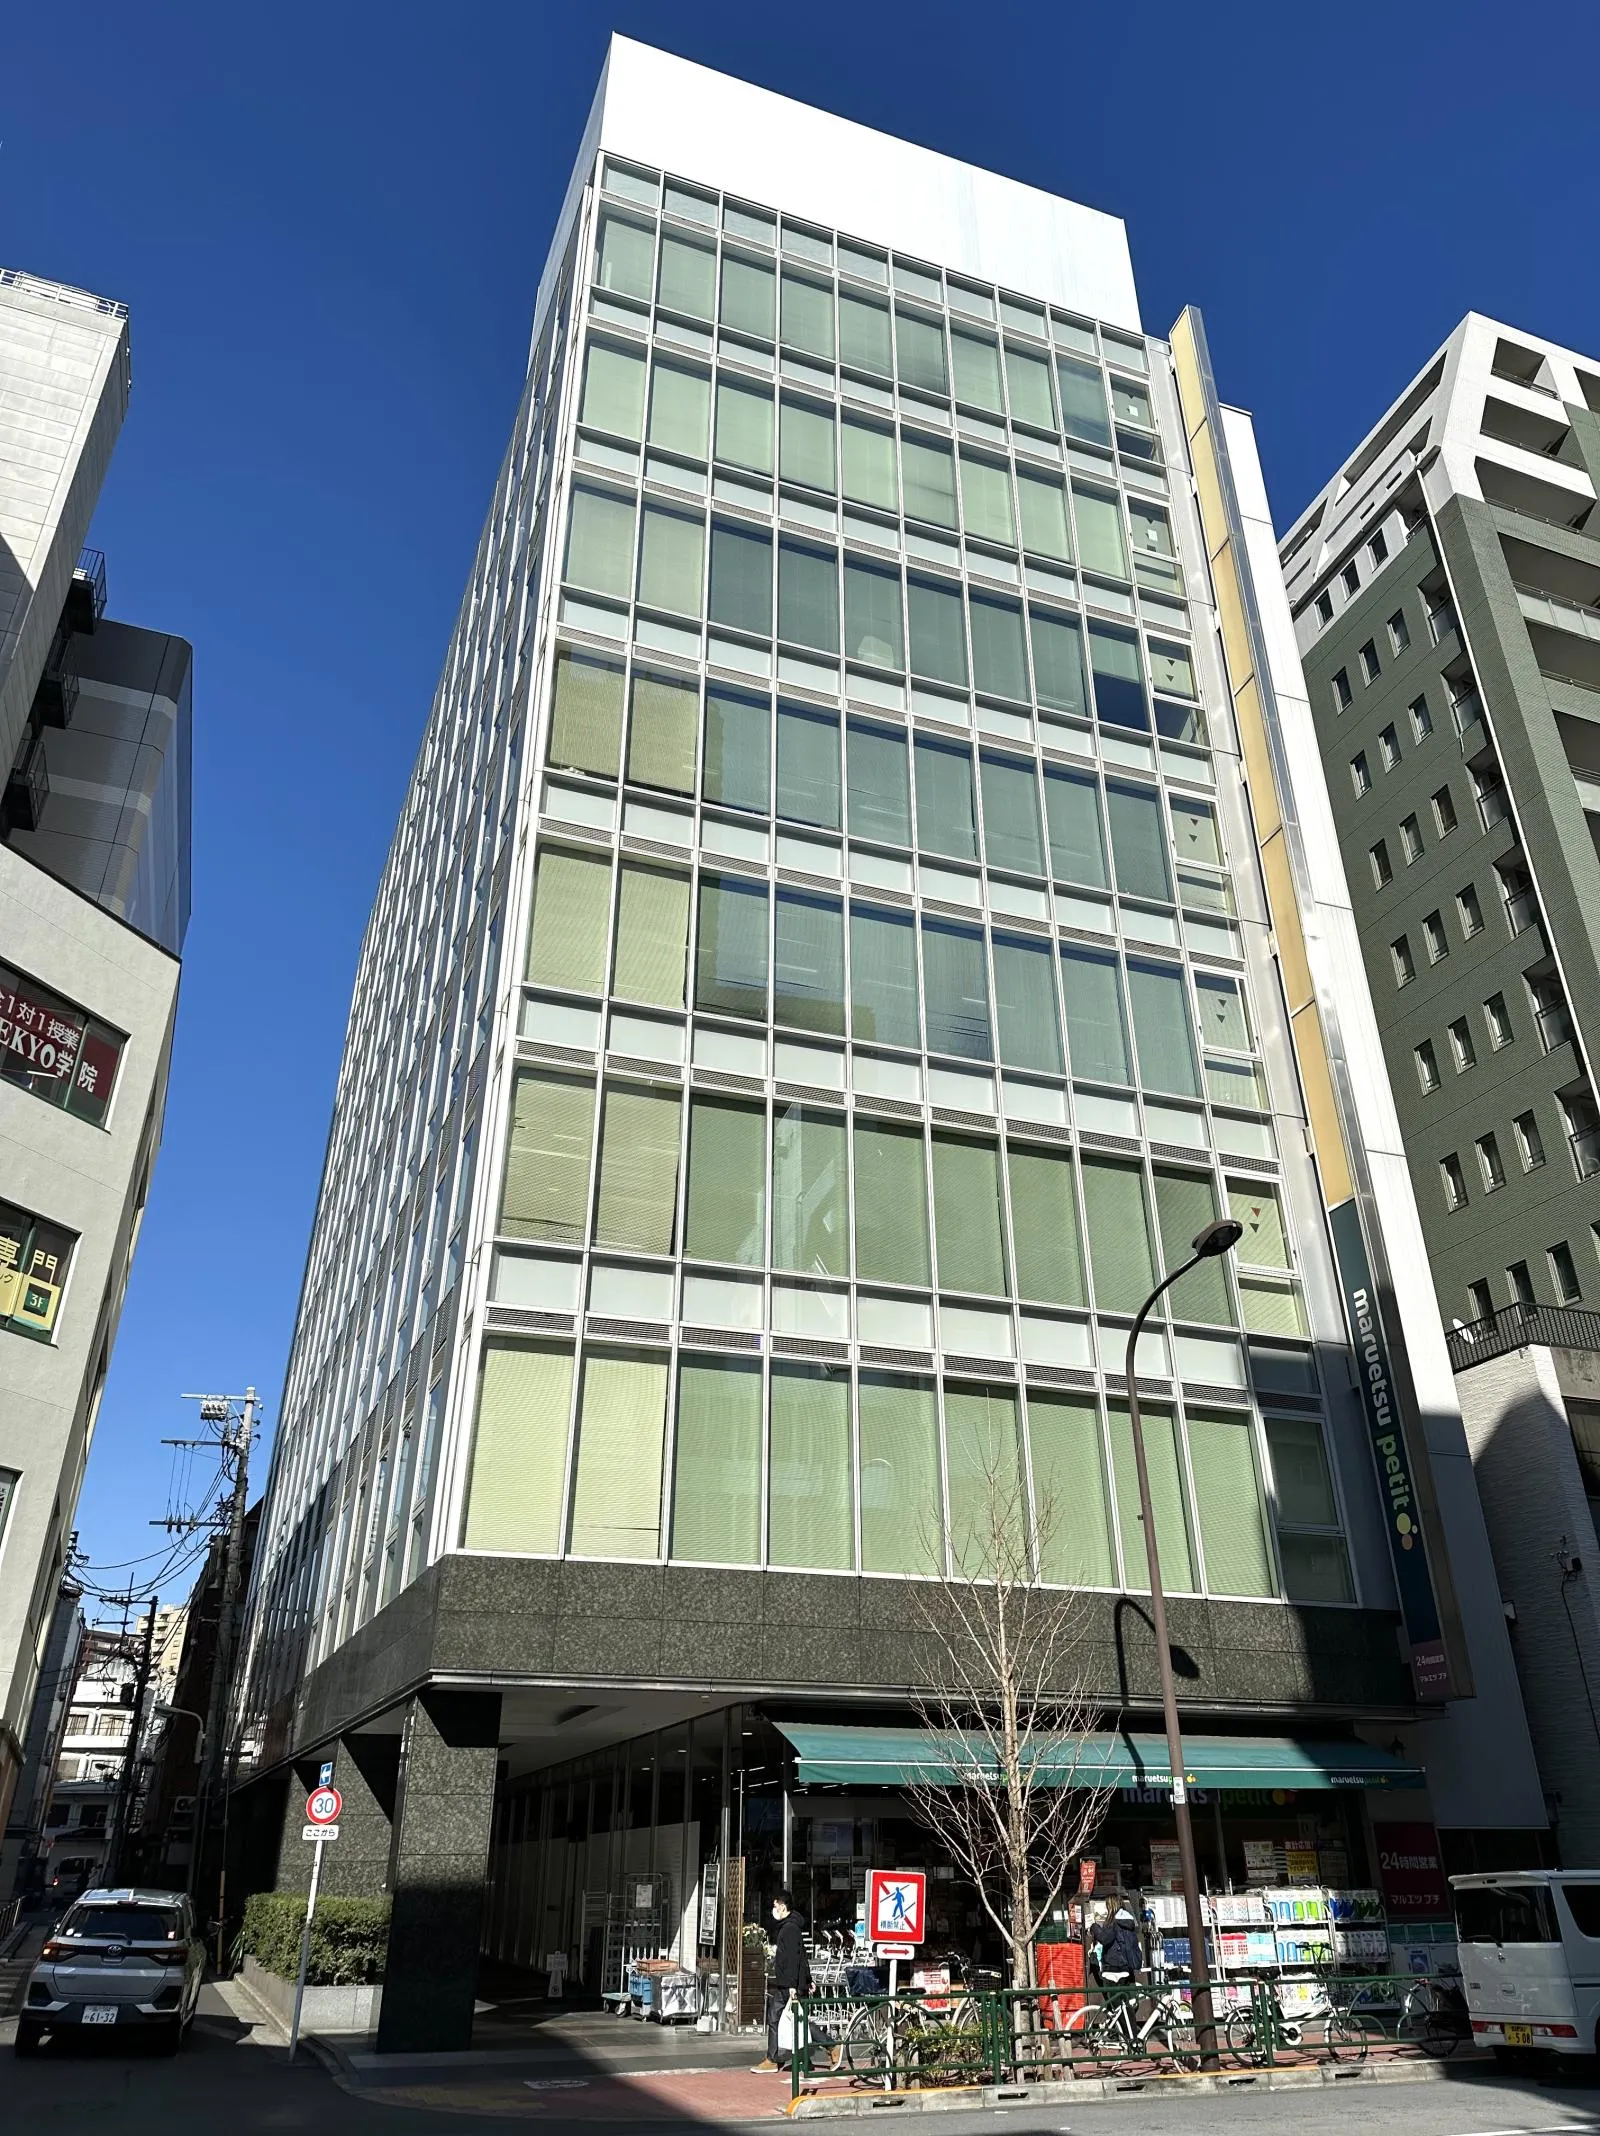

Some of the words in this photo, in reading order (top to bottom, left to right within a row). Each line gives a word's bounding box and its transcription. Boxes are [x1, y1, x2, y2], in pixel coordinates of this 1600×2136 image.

[29, 1293, 47, 1308] 3F
[1353, 1288, 1392, 1426] maruetsu
[1376, 1434, 1410, 1510] petit
[315, 1797, 334, 1814] 30
[305, 1829, 336, 1837] ここから
[1380, 1851, 1439, 1870] 24時間営業
[880, 1920, 906, 1931] 横断禁止
